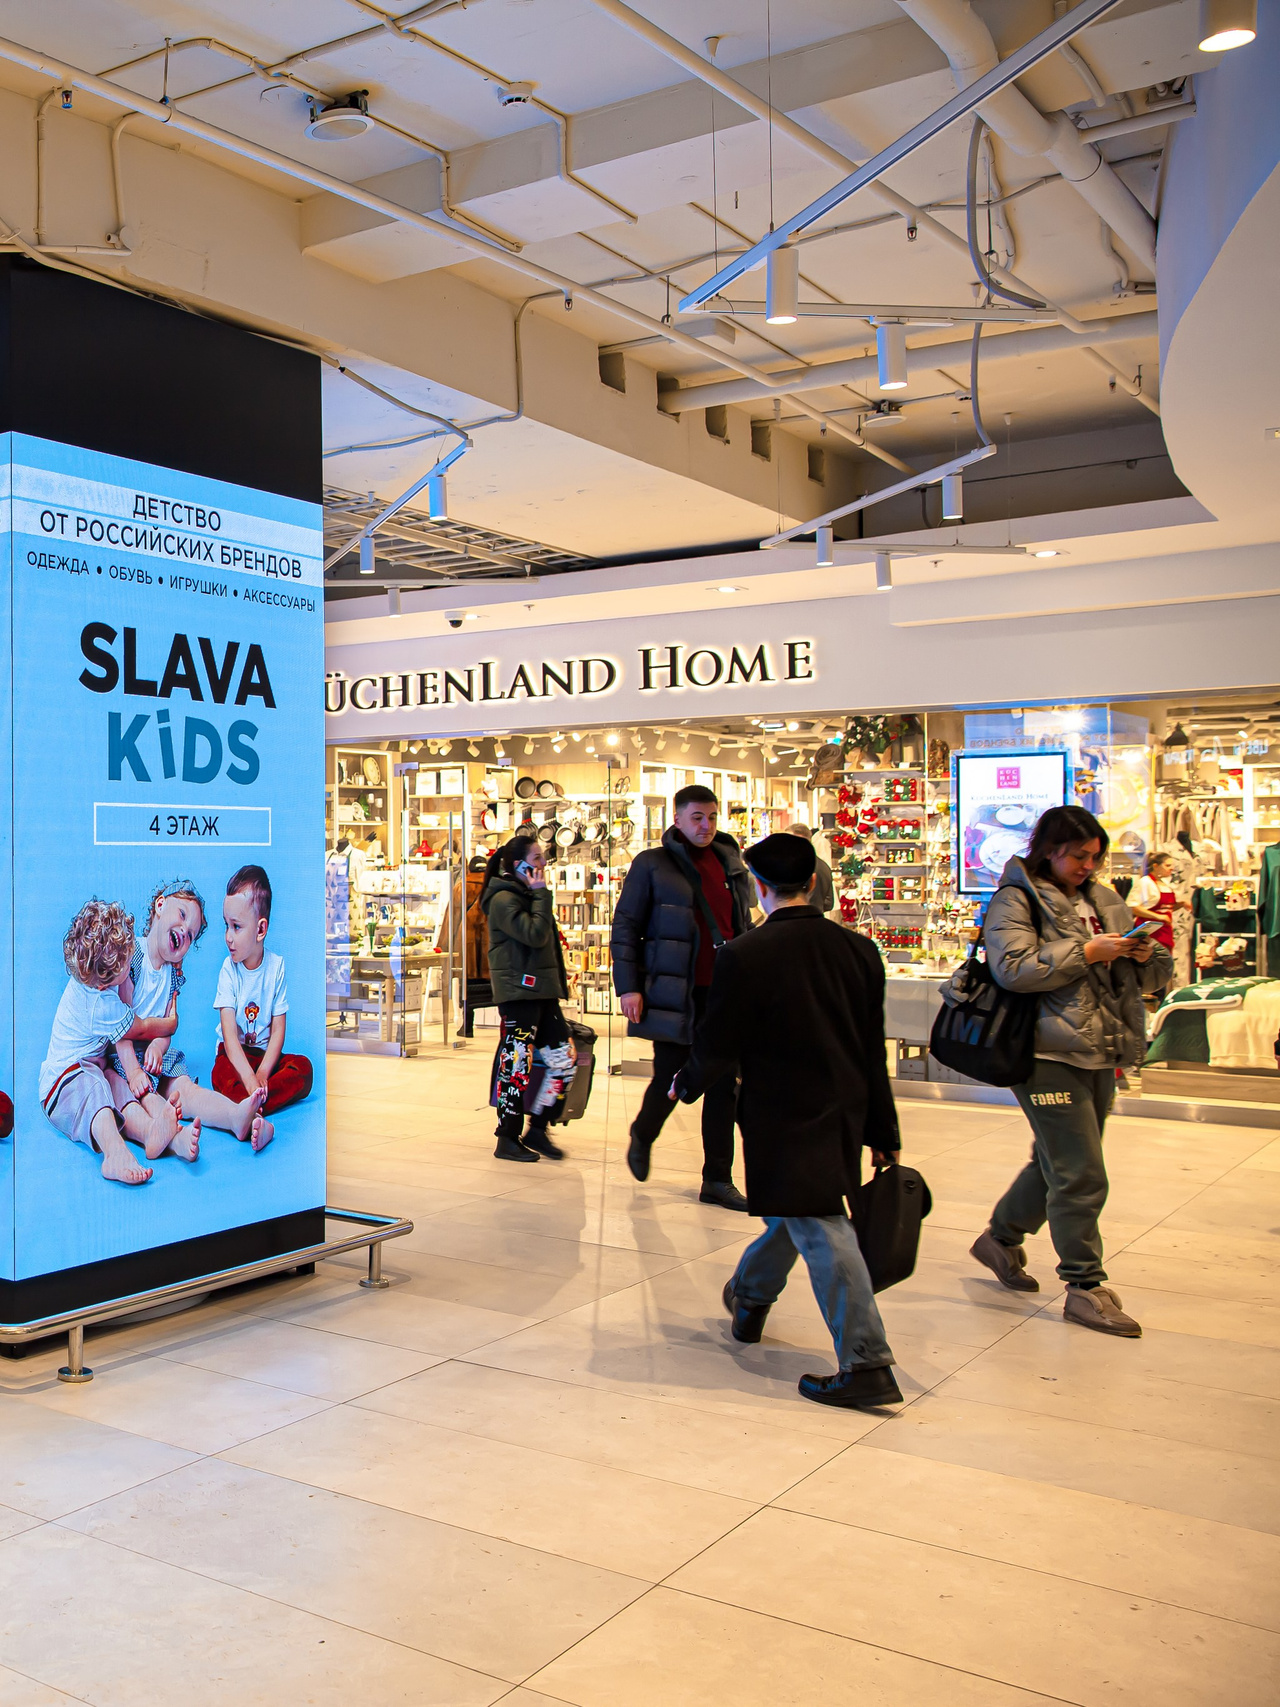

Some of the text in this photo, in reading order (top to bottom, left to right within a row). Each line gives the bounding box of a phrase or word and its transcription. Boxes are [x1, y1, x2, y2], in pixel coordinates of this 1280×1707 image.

[132, 494, 221, 531] ДЕТСТВО
[40, 510, 302, 580] ОТ РОССИЙСКИХ БРЕНДОВ
[27, 552, 315, 612] ОДЕЖДА ОБУВЬ ИГРУШКИ АКСЕССУАРЫ
[79, 621, 277, 709] SLAVA
[149, 815, 219, 837] 4 ЭТАЖ
[1030, 1091, 1072, 1106] FORCE
